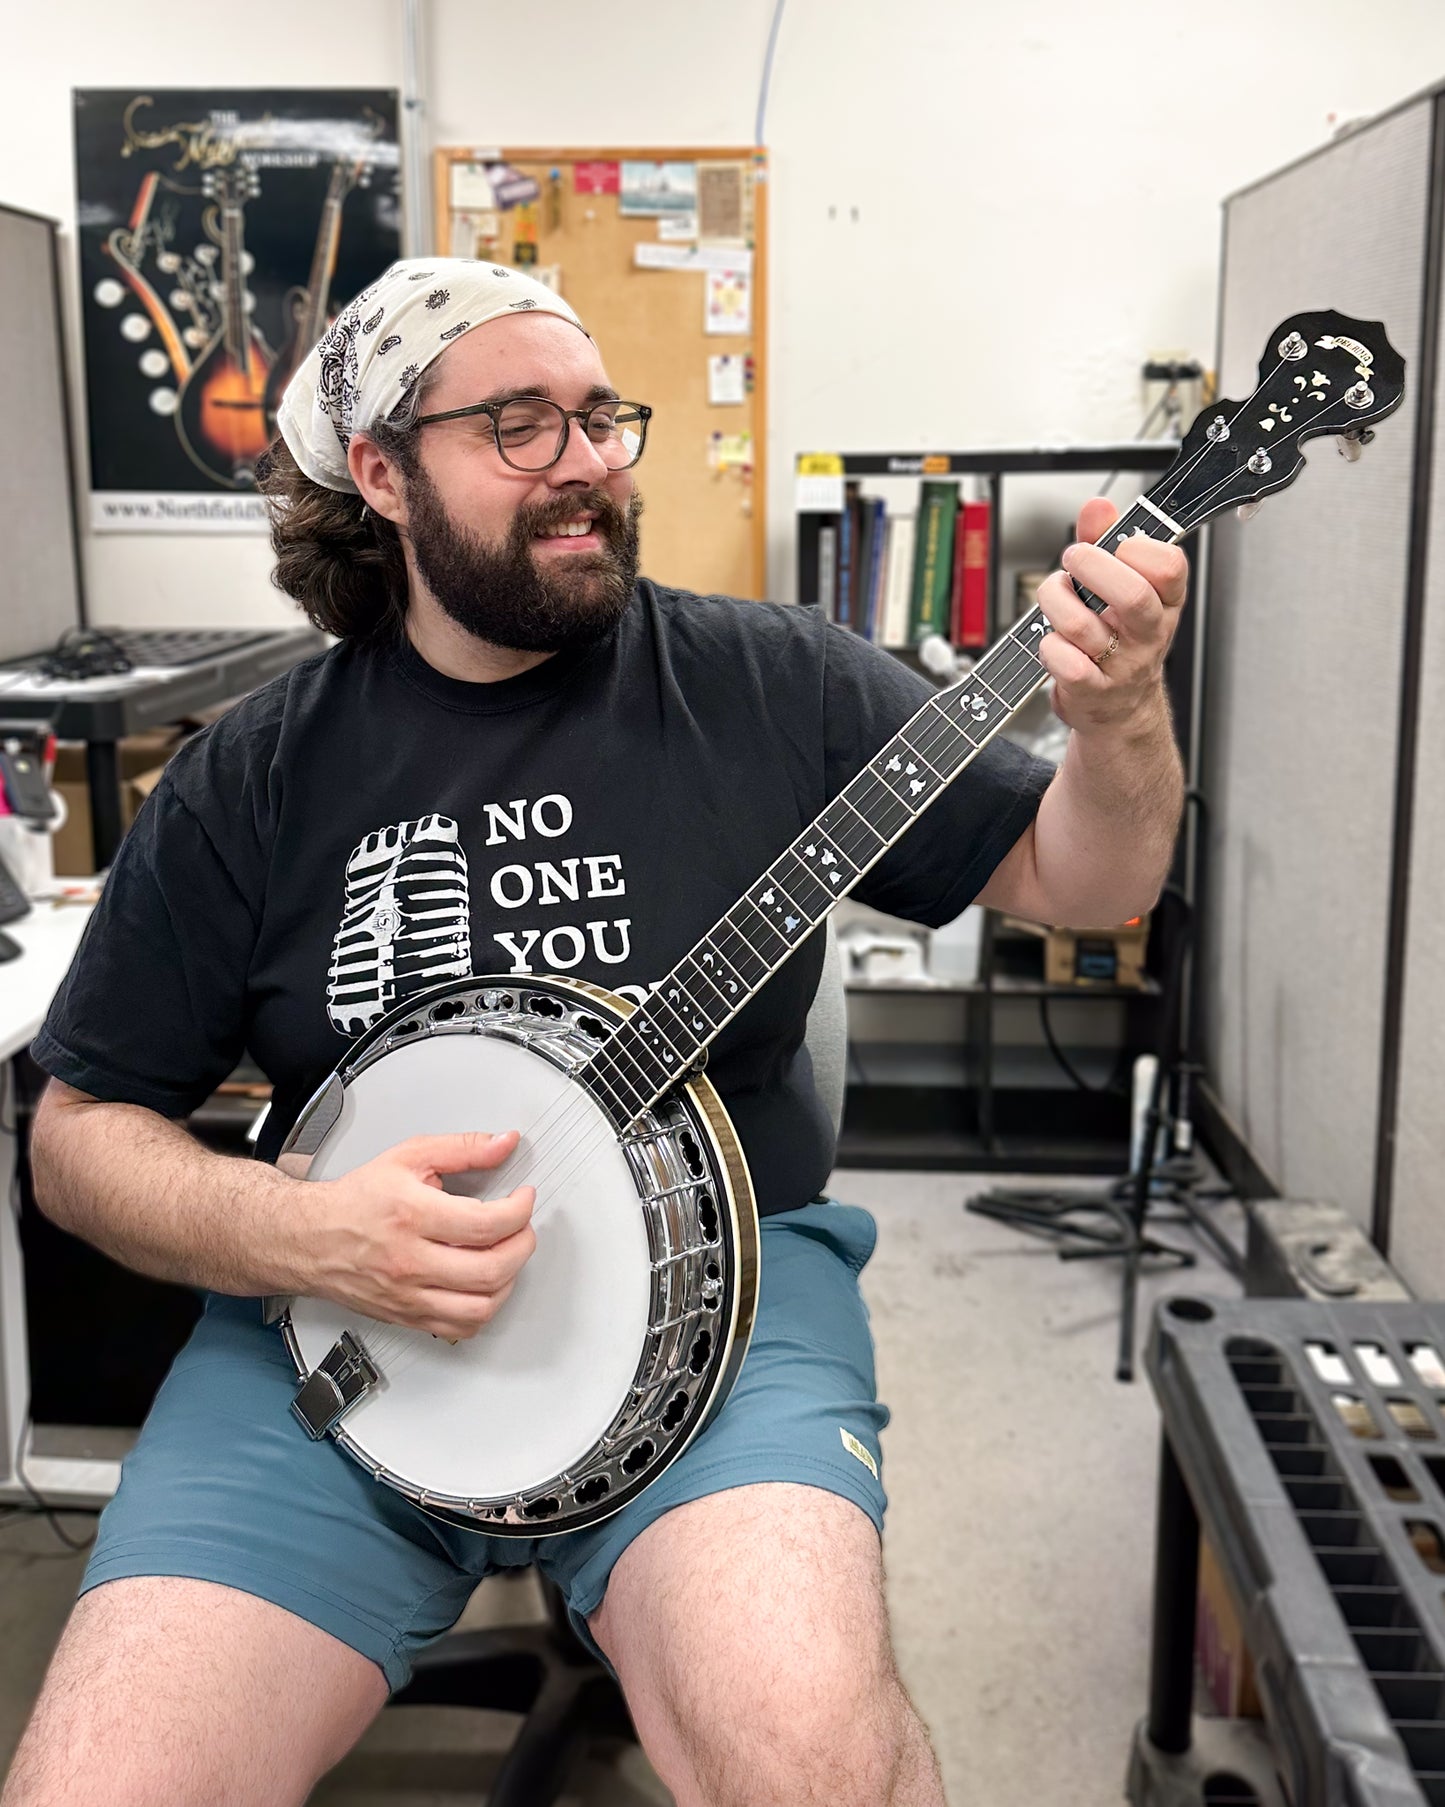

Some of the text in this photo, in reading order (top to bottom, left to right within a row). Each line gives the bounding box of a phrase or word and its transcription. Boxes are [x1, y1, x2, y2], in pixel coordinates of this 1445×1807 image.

[210, 110, 239, 125] THE
[483, 793, 573, 847] NO
[490, 854, 626, 909] ONE
[493, 918, 632, 974] YOU
